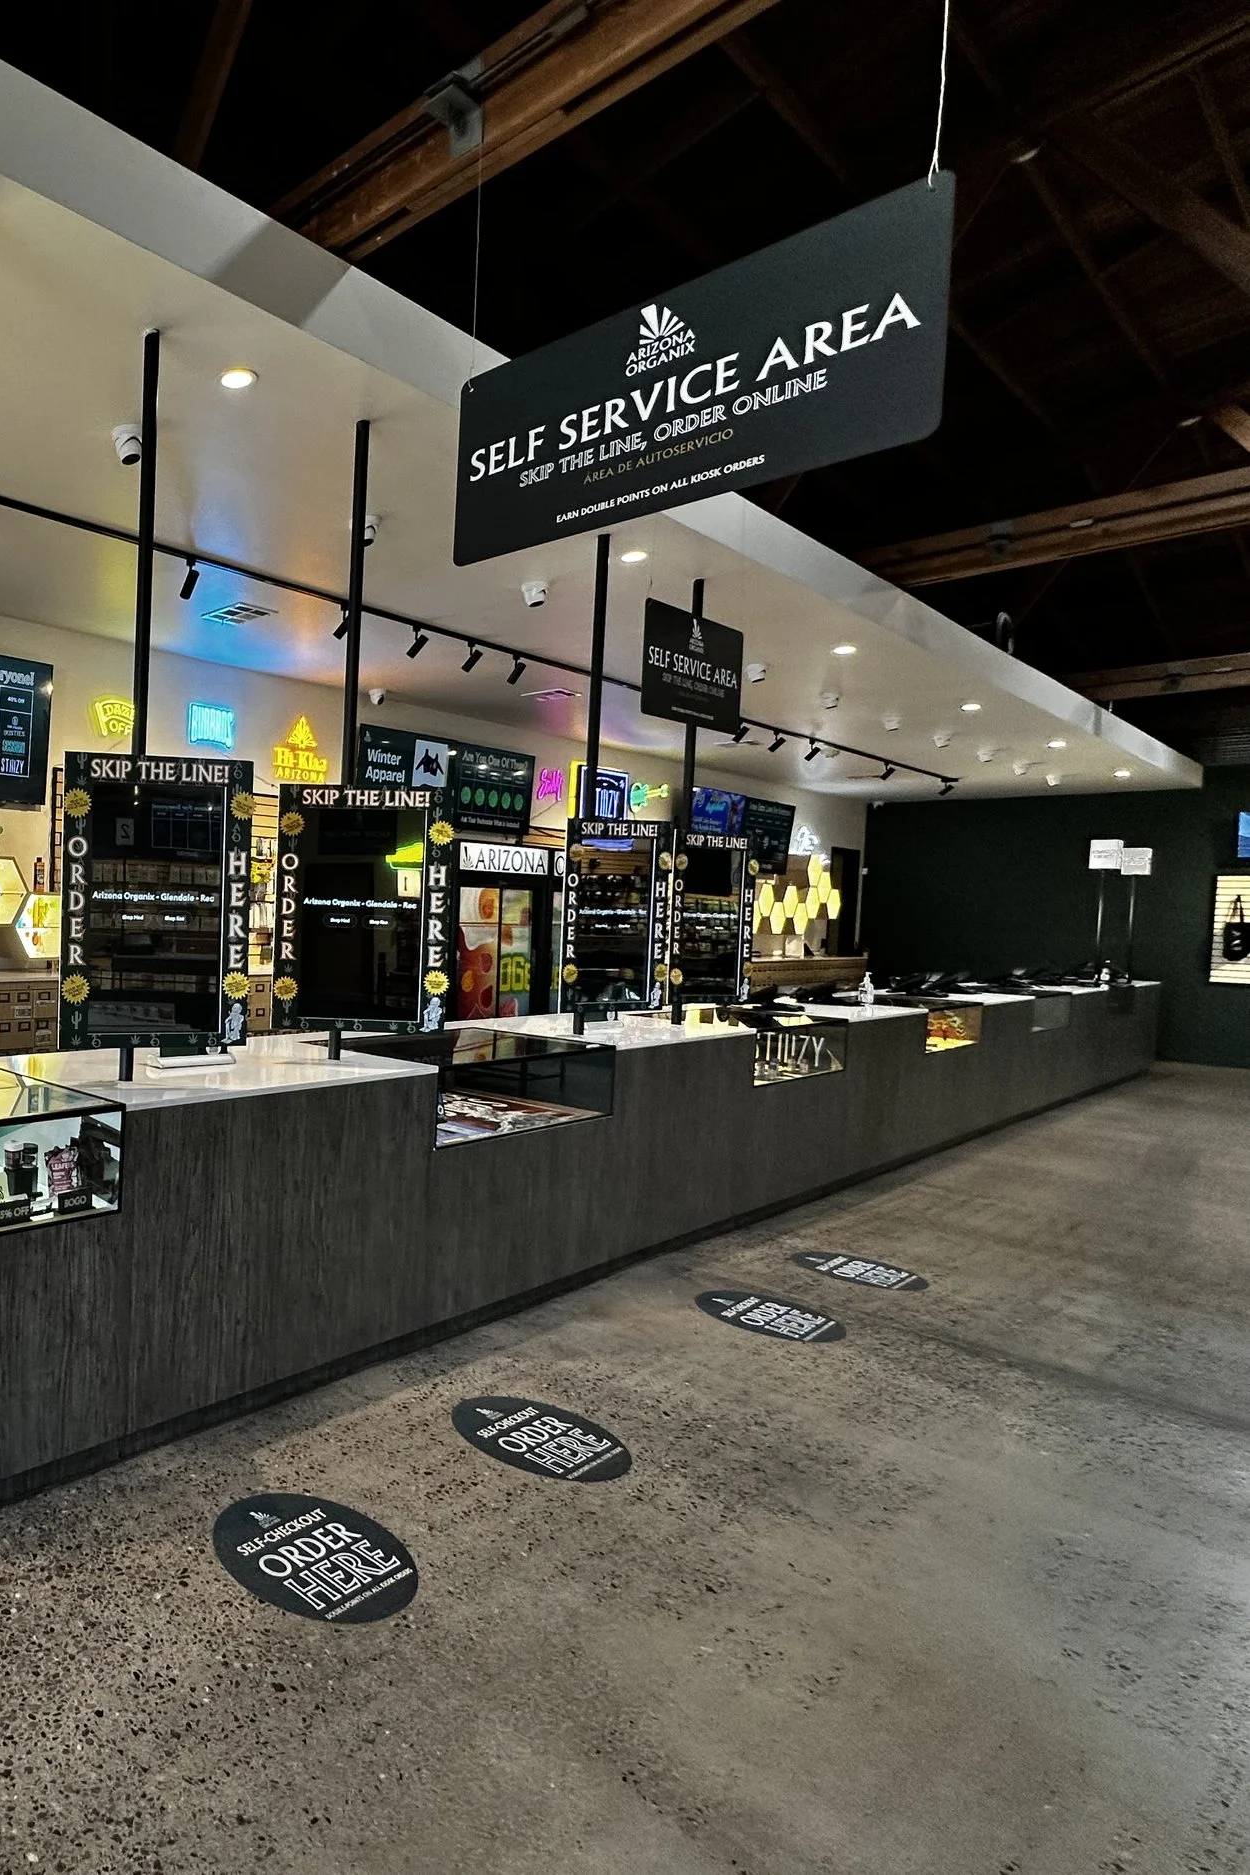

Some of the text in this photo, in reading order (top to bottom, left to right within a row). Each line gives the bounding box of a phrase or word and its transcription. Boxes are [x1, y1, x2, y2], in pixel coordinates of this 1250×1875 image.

[625, 340, 696, 378] ORGANIX
[626, 329, 696, 365] ARIZONA
[469, 292, 922, 482] SELF SERVICE AREA
[519, 368, 828, 488] SKIP THE LINE, ORDER ONLINE
[618, 460, 633, 474] DE
[636, 428, 734, 469] AUTOSERVICIO
[556, 454, 765, 524] EARN DOUBLE POINTS ON ALL KIOSK ORDERS
[648, 645, 671, 669] SELF
[672, 653, 712, 682] SERVICE
[712, 667, 738, 690] AREA
[90, 758, 231, 784] SKIP THE LINE!
[275, 767, 325, 784] ARIZONA
[365, 765, 406, 784] Apparel
[367, 748, 402, 766] Winter
[302, 789, 431, 808] SKIP THE LINE!
[581, 822, 658, 837] SKIP THE LINE!
[686, 833, 748, 850] SKIP THE LINE!
[474, 848, 546, 874] ARIZONA
[67, 835, 89, 966] ORDER
[226, 851, 248, 969] HERE
[280, 853, 299, 961] ORDER
[426, 865, 448, 968] HERE
[565, 873, 579, 959] ORDER
[653, 881, 667, 960] HERE
[672, 879, 684, 955] ORDER
[742, 889, 754, 958] HERE
[13, 1205, 30, 1218] OFF
[739, 1302, 792, 1326] ORDER
[763, 1309, 827, 1339] HERE
[476, 1406, 540, 1438] SELF-CHECKOUT
[497, 1416, 573, 1453] ORDER
[524, 1427, 612, 1474] HERE
[236, 1507, 327, 1557] SELF-CHECKOUT
[258, 1522, 363, 1578] ORDER
[282, 1539, 401, 1611] HERE
